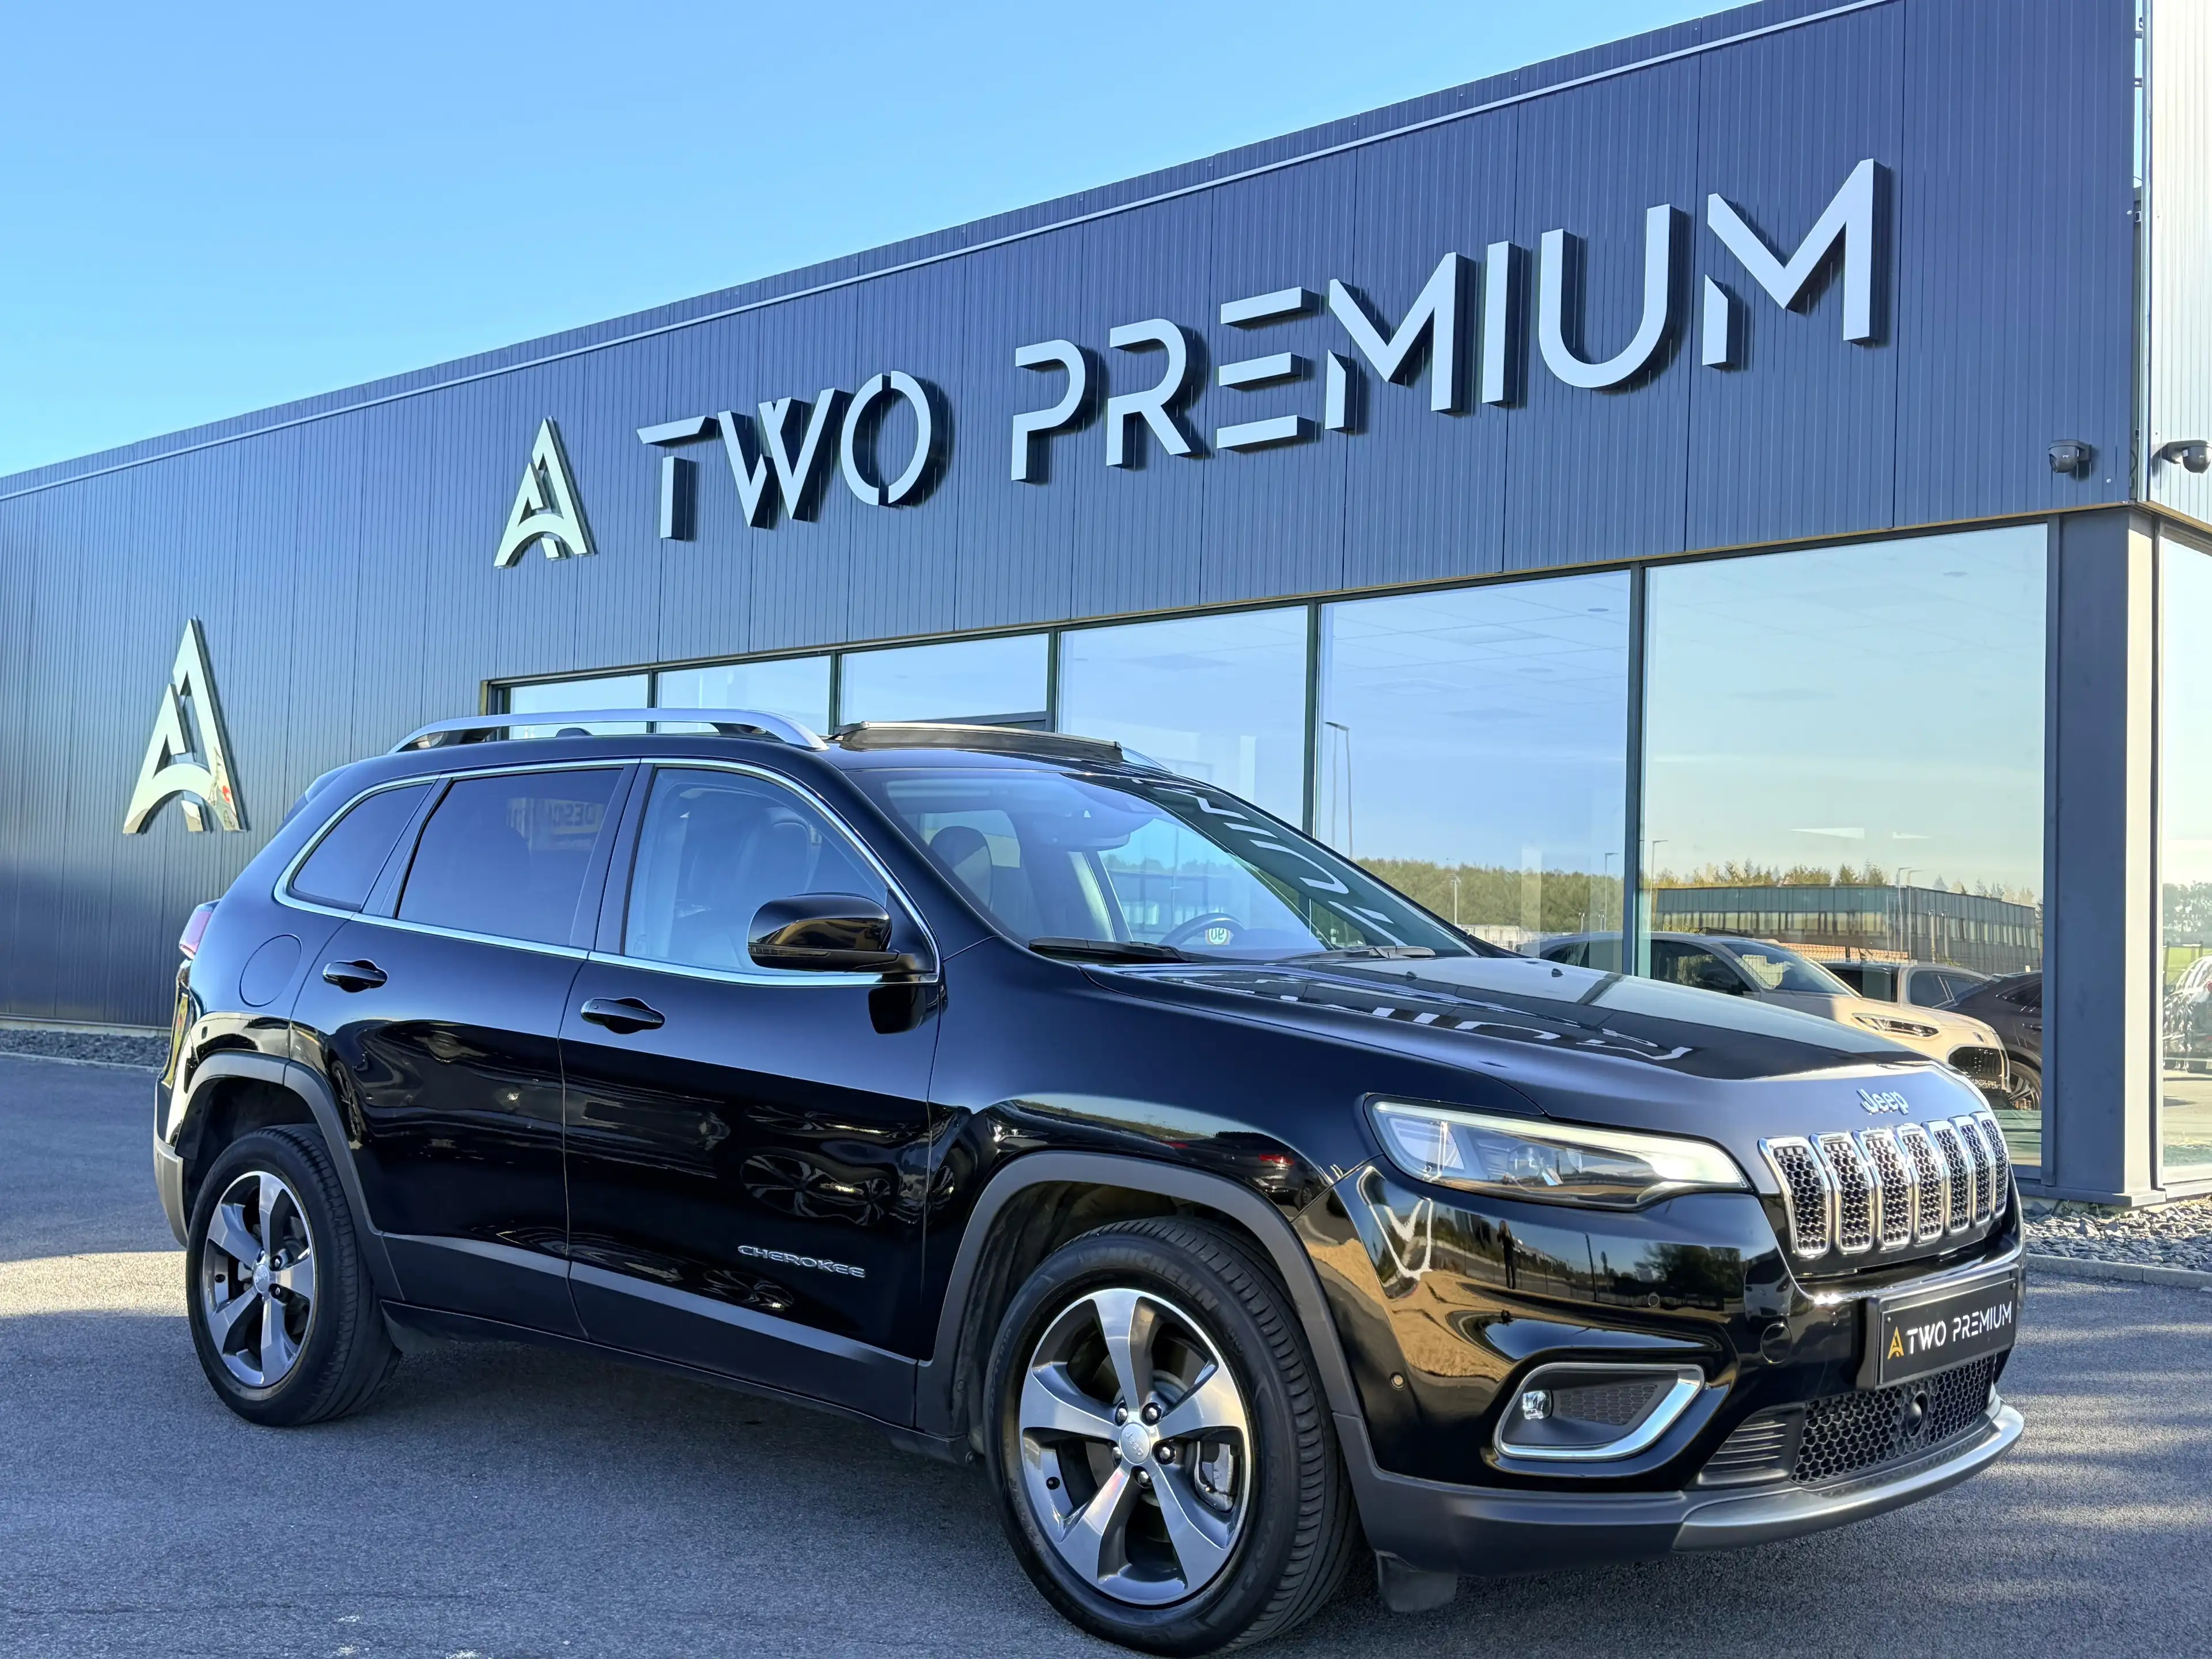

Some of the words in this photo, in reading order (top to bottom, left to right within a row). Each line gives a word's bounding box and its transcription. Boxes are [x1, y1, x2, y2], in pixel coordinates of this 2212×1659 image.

[494, 416, 594, 569] A
[637, 370, 932, 540] TWO
[1011, 158, 1876, 483] PREMIUM
[123, 616, 250, 835] A
[1856, 1088, 1909, 1115] Jeep
[737, 1245, 865, 1278] CHEROKEE
[1107, 1247, 1219, 1311] MICHELIN
[1887, 1326, 1904, 1359] A
[1907, 1320, 1947, 1355] TWO
[1953, 1301, 2012, 1342] PREMIUM
[1124, 1431, 1144, 1457] Jeep
